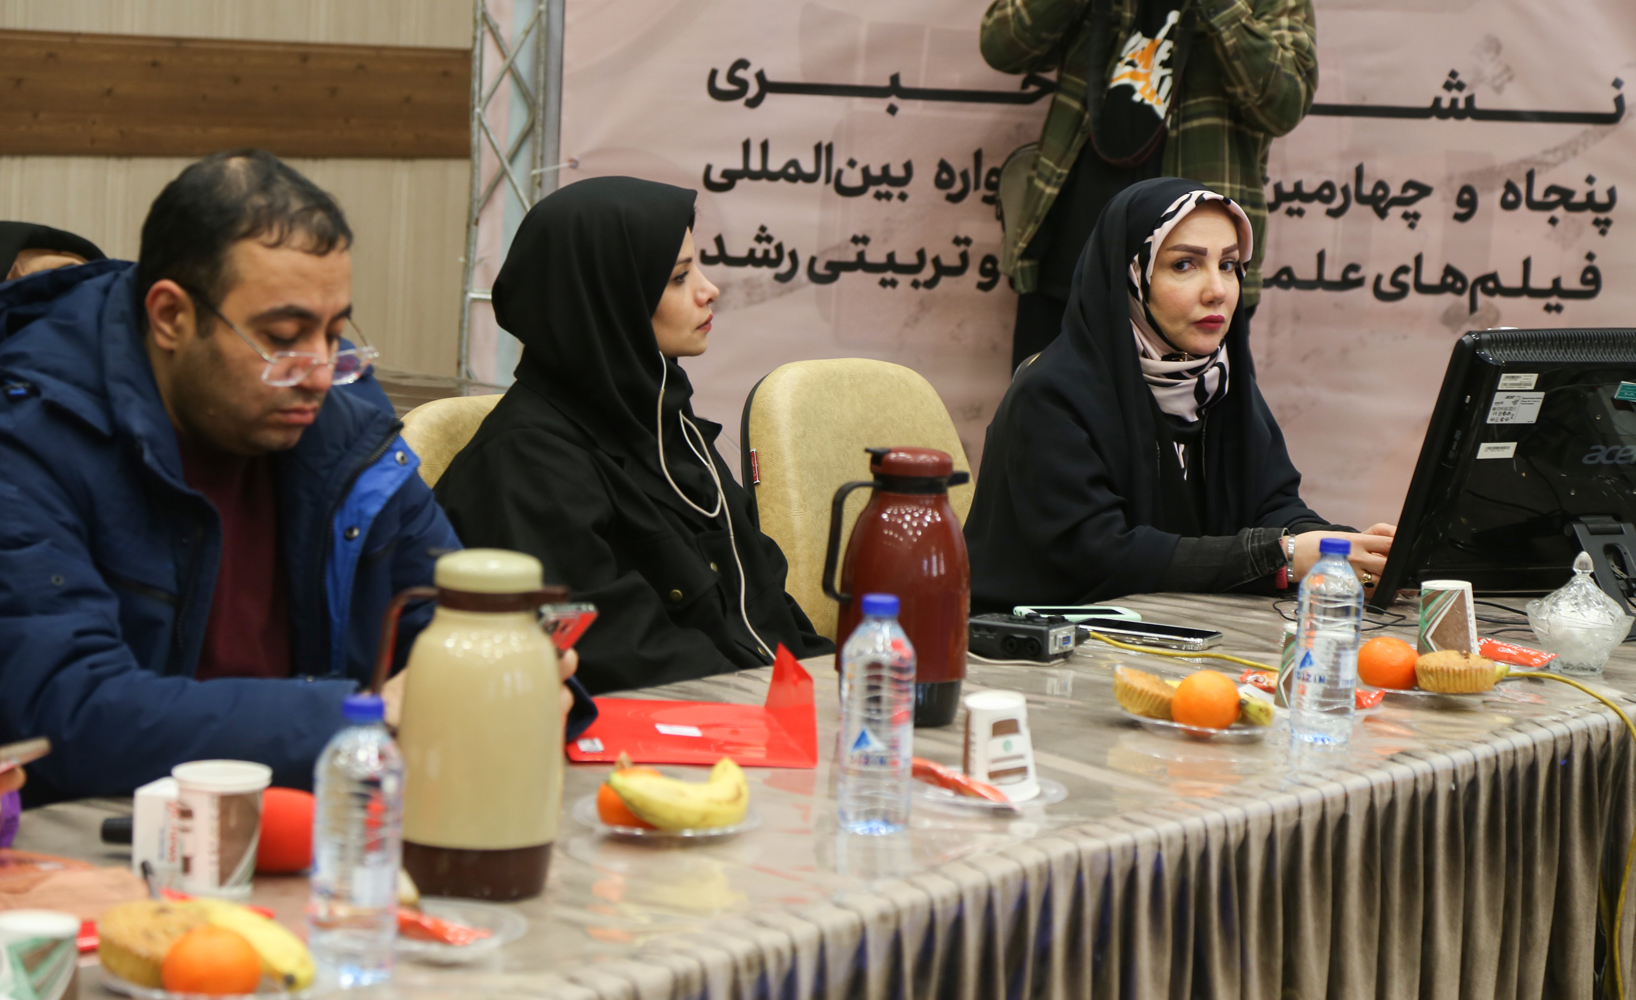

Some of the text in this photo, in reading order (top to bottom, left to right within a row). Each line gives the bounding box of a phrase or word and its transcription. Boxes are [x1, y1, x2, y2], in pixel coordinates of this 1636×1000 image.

[934, 147, 1000, 205] واره
[1453, 184, 1478, 222] و
[1500, 168, 1617, 237] پنجاه
[699, 225, 799, 284] رشد
[807, 235, 973, 290] تربیتی
[1262, 249, 1366, 291] علم
